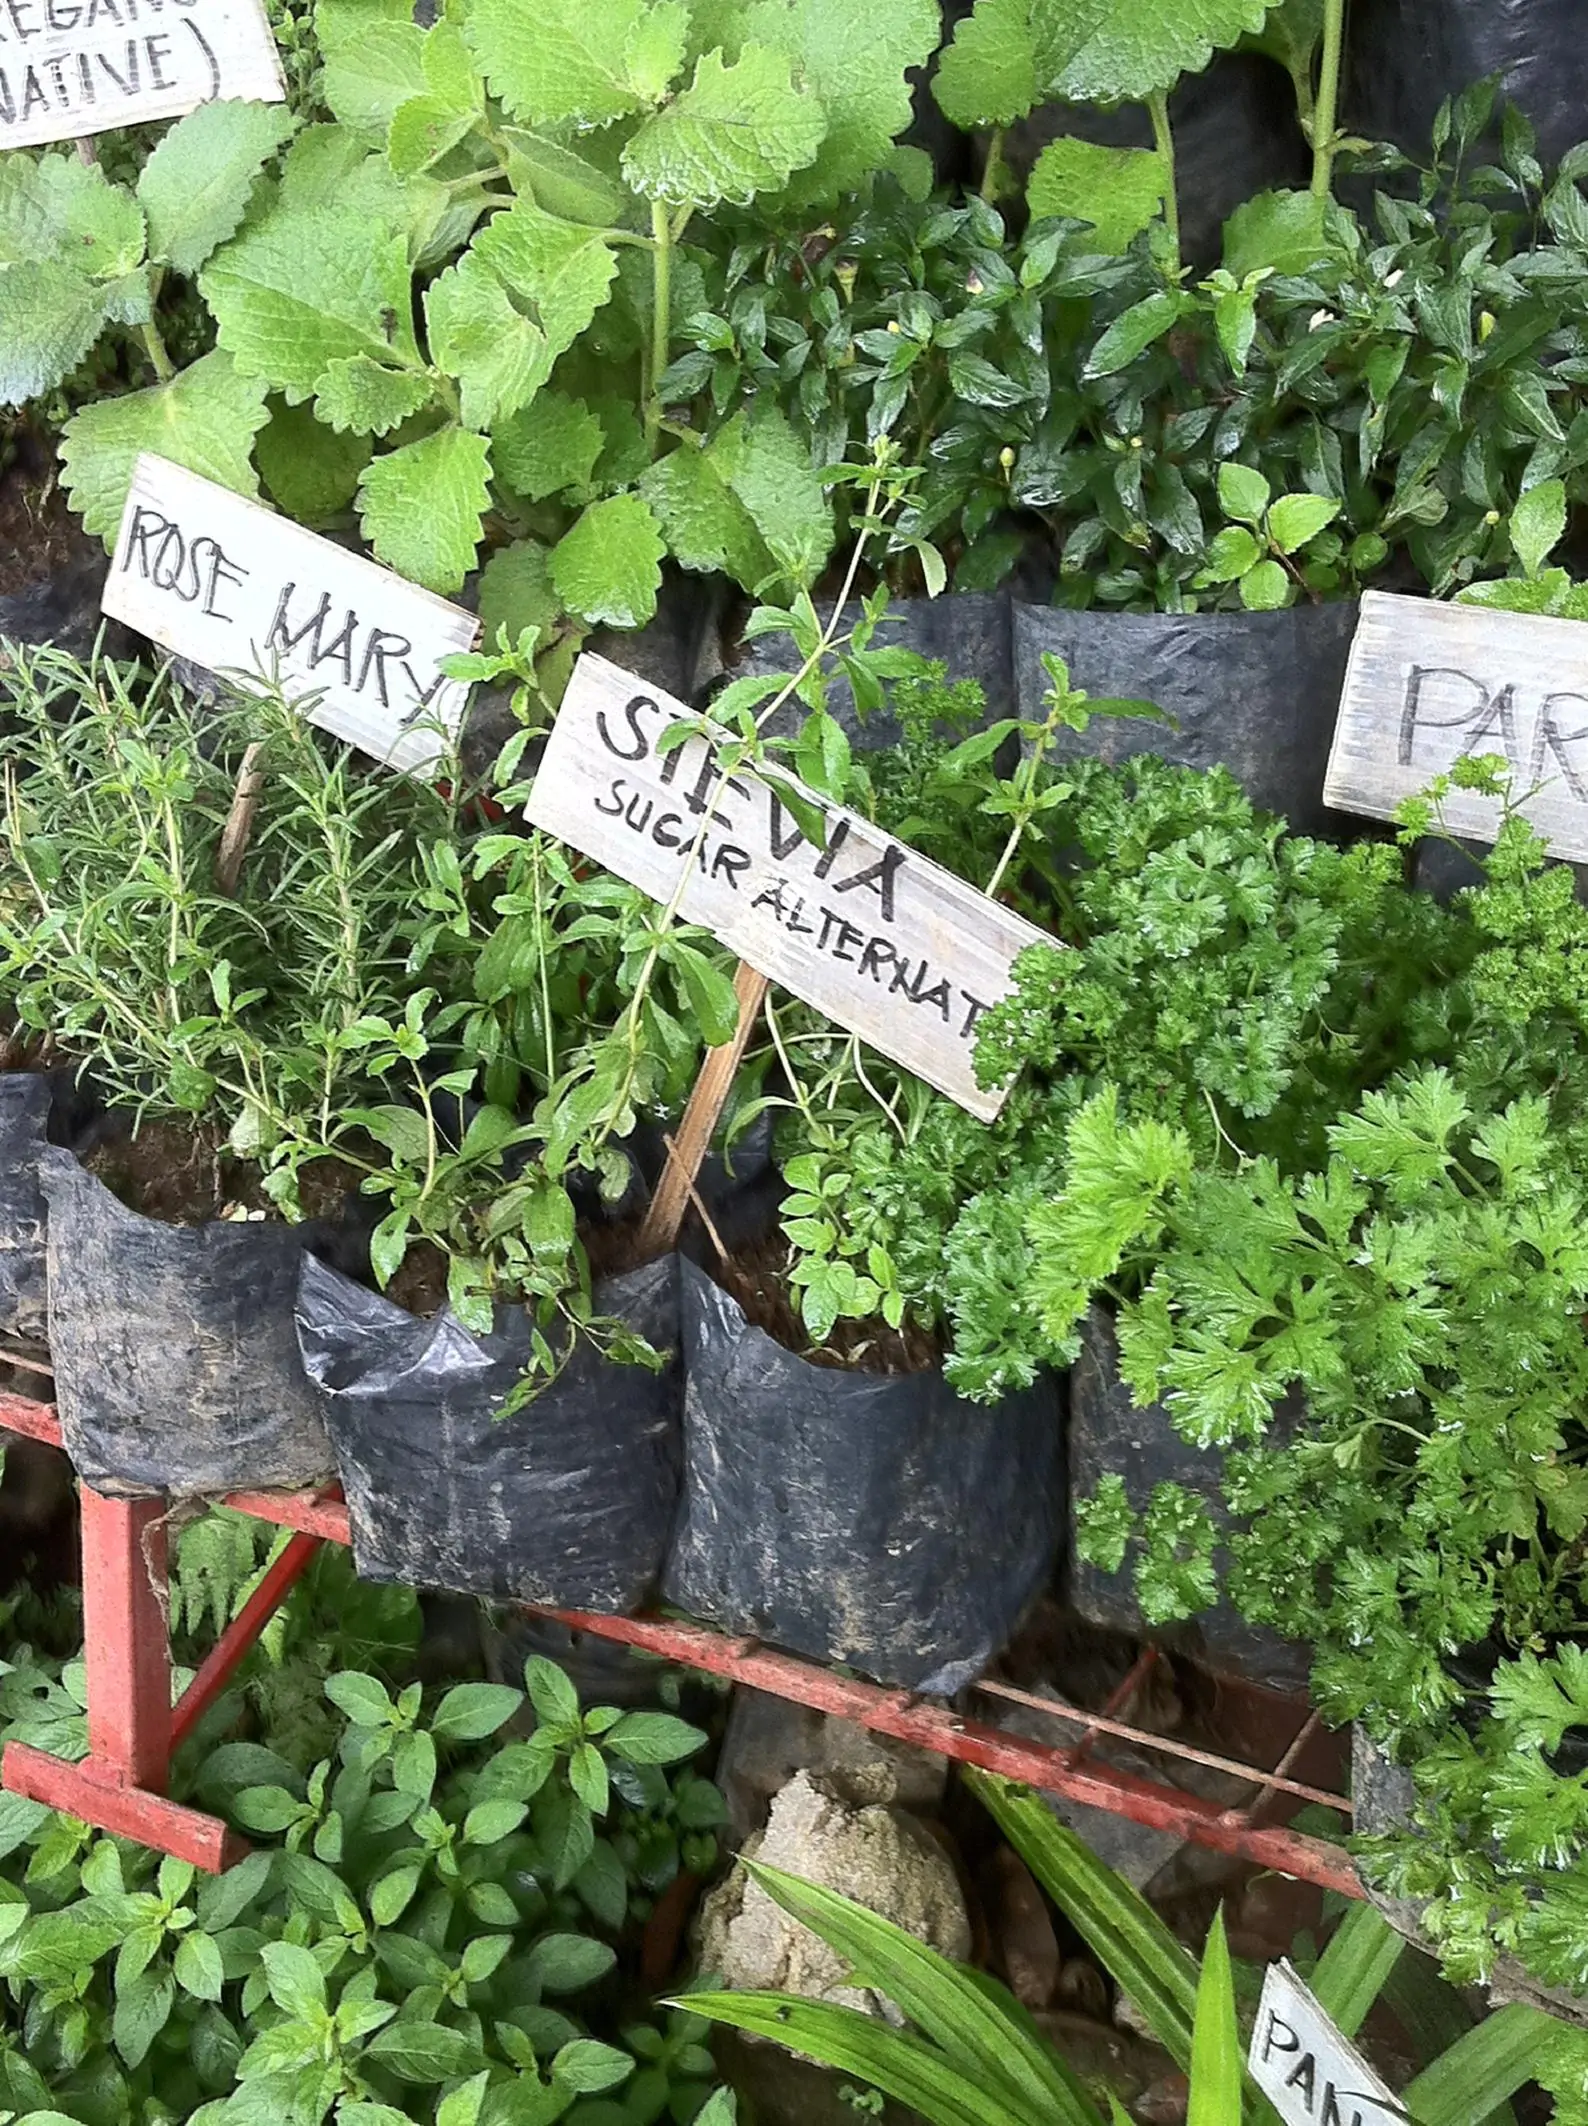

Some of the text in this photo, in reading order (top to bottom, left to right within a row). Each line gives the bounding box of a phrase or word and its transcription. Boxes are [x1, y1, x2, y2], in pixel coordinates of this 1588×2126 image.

[119, 505, 446, 725] ROSE MARY
[1398, 664, 1588, 803] PAR
[751, 878, 994, 1038] ALTERNAT
